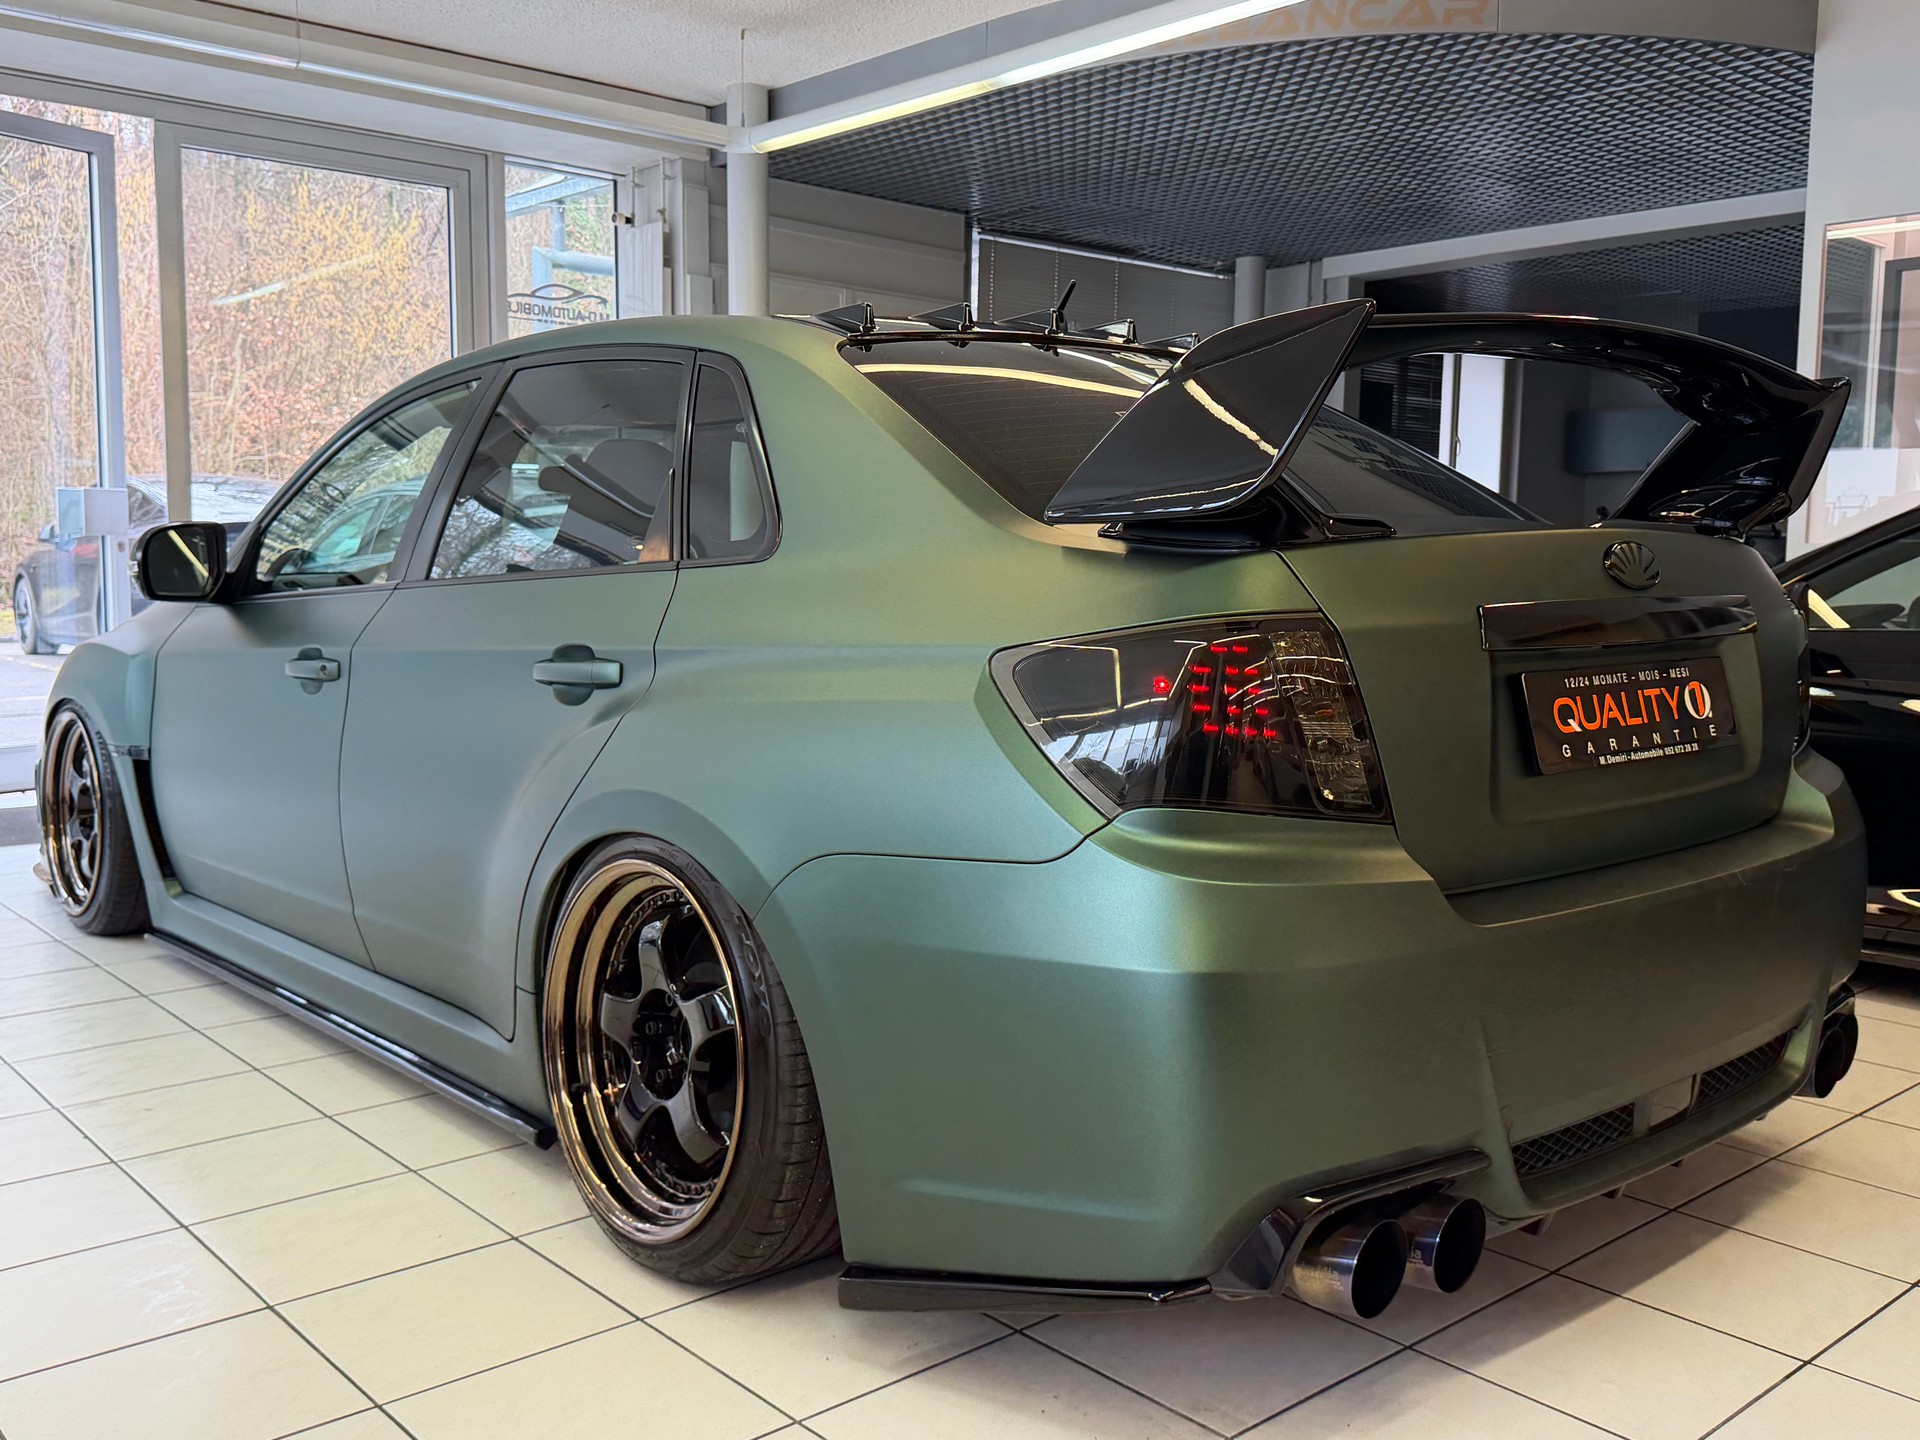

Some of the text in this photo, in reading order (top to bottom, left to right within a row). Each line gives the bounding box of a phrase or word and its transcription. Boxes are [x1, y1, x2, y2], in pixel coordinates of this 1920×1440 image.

[1564, 677, 1590, 688] 12/24
[1593, 672, 1629, 685] MONATE
[1638, 669, 1660, 681] MOIS
[1669, 667, 1690, 678] MESI
[1553, 686, 1680, 734] QUALITY
[1562, 724, 1717, 758] GARANTIE
